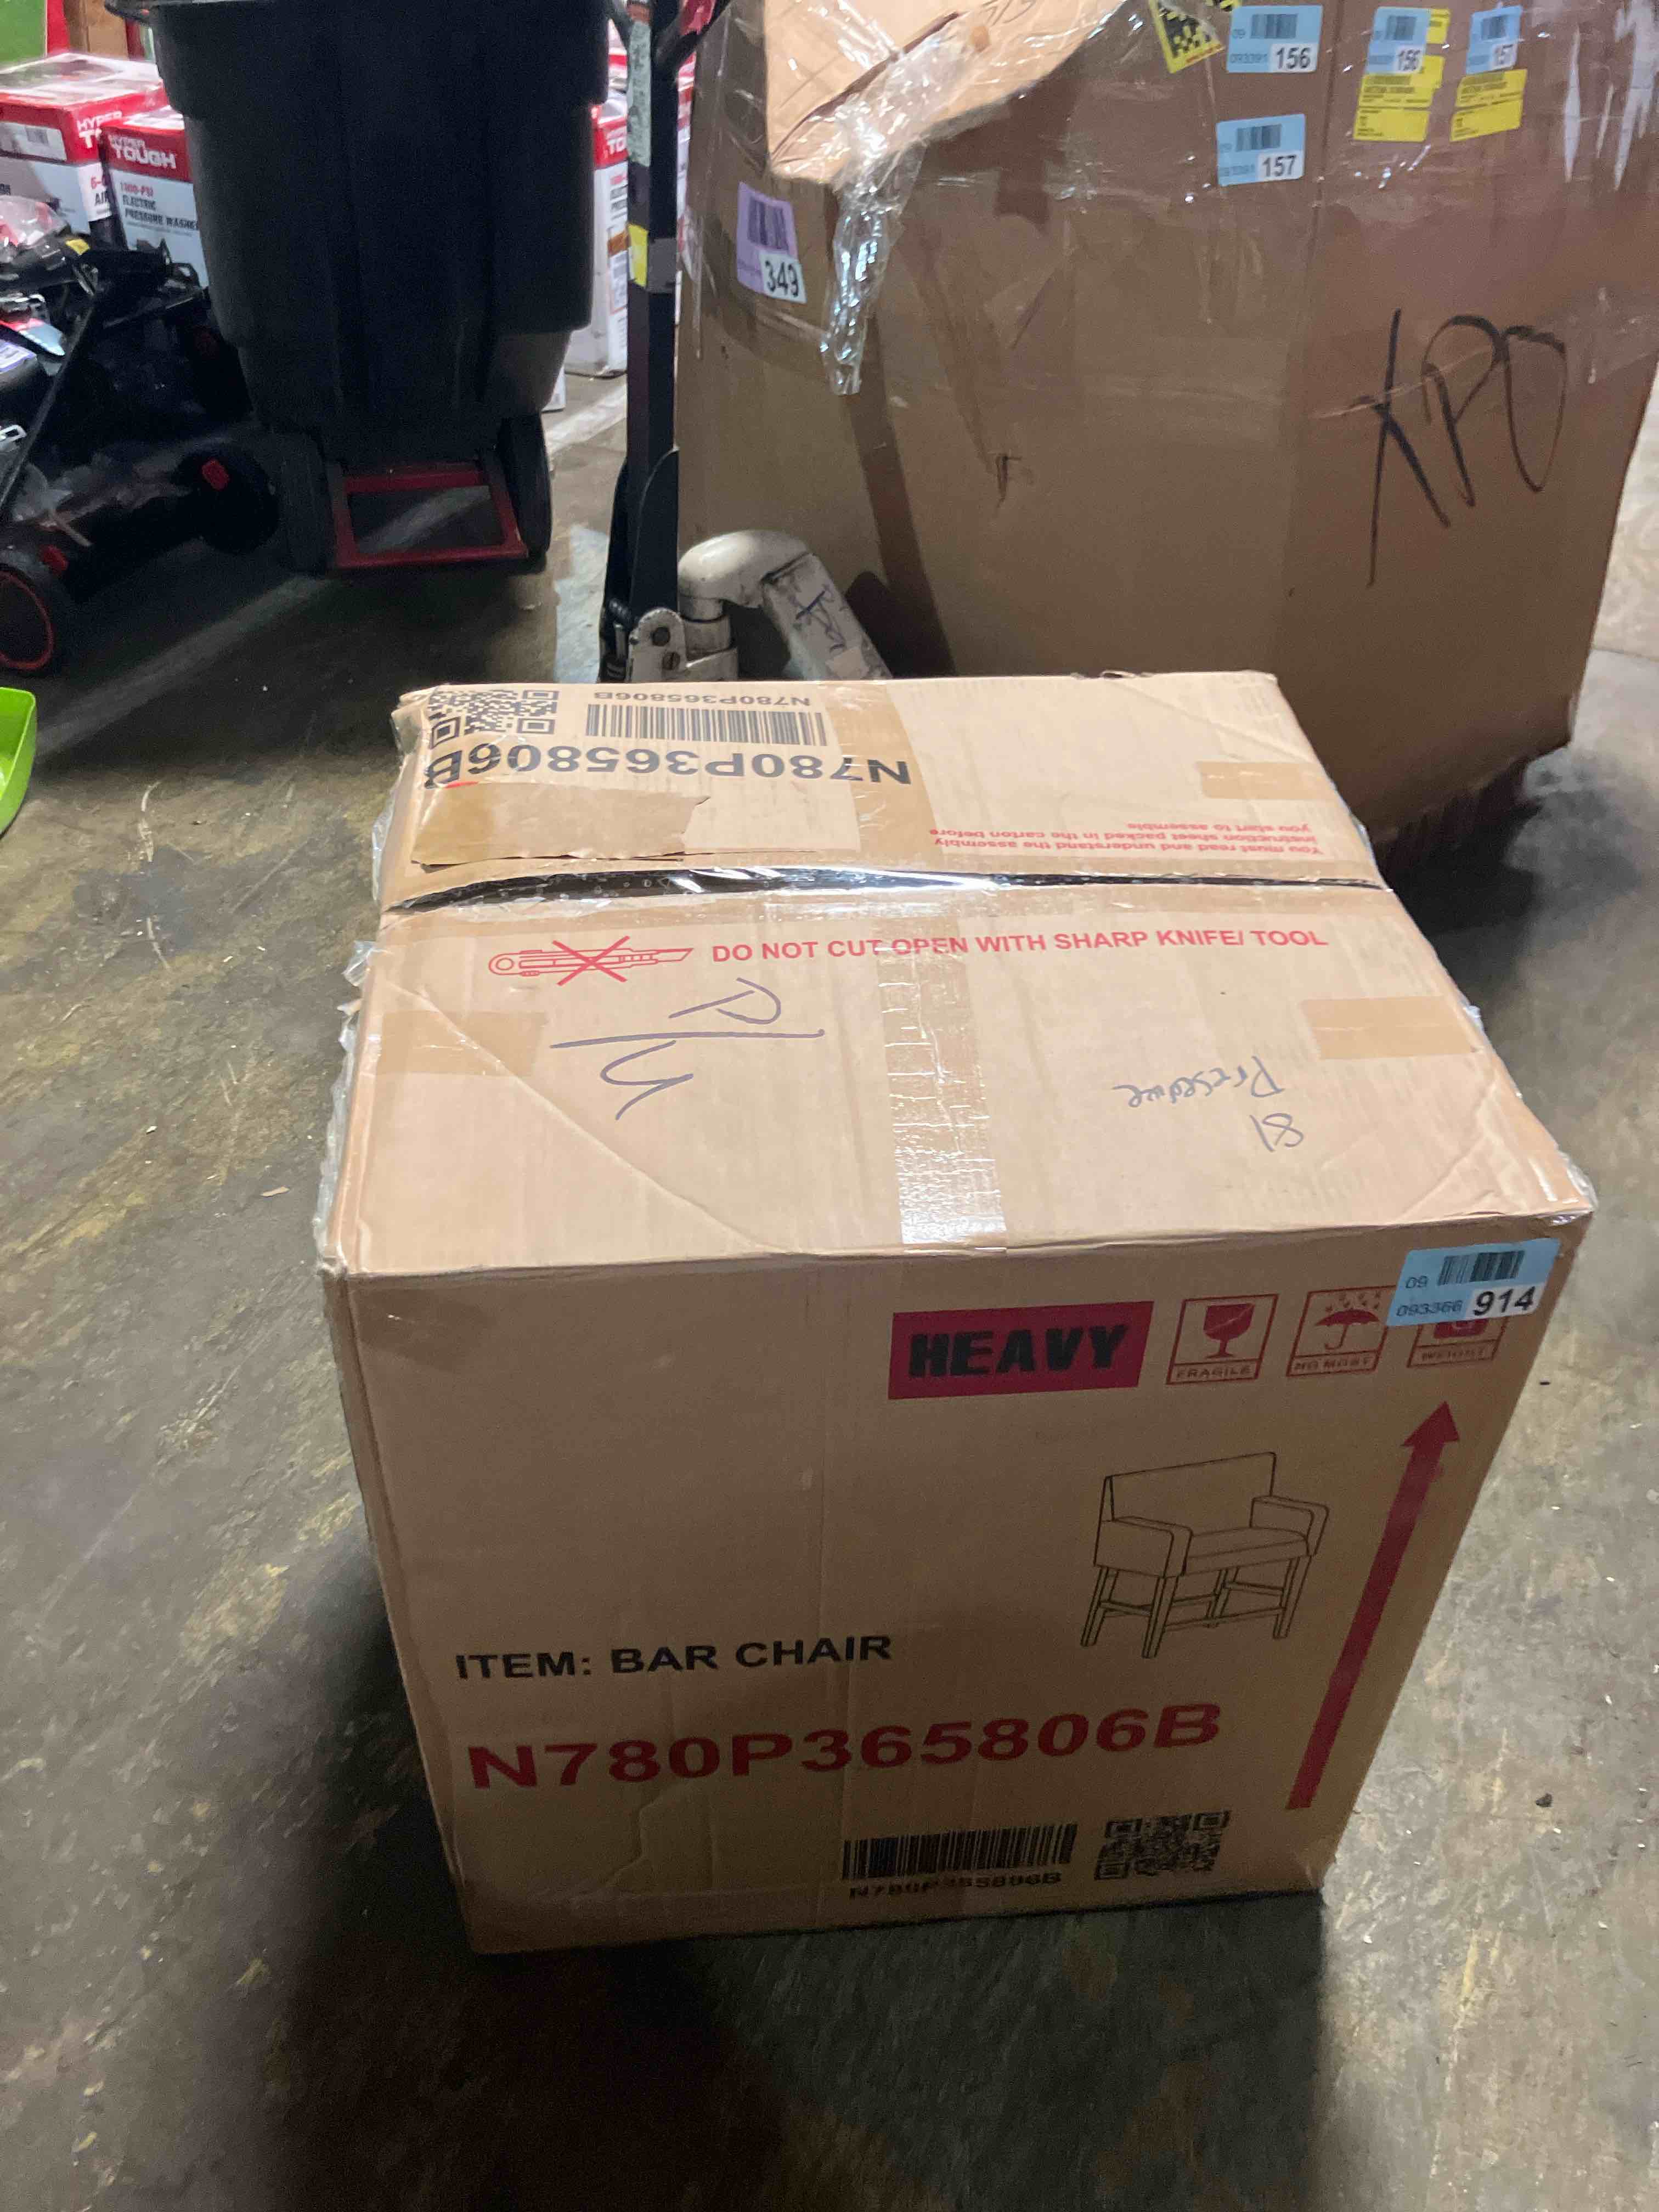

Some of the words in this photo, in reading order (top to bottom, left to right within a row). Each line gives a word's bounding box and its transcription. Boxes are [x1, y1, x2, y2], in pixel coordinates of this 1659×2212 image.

[1277, 47, 1311, 70] 156
[112, 144, 177, 170] TOUGH
[1263, 154, 1296, 178] 157
[594, 691, 810, 707] N780P365806B
[424, 742, 911, 789] N780P365806B
[1127, 822, 1207, 831] assemble
[1278, 823, 1310, 832] you
[929, 828, 985, 838] before
[1051, 831, 1078, 839] the
[1104, 832, 1166, 840] packed
[1172, 833, 1218, 842] sheet
[934, 837, 1017, 848] assembly
[1223, 834, 1317, 843] instruction
[1023, 840, 1051, 849] the
[1056, 841, 1155, 850] understand
[1160, 842, 1192, 851] and
[1198, 843, 1235, 851] read
[1240, 844, 1284, 853] must
[1289, 845, 1324, 855] You
[713, 944, 753, 962] DO
[762, 941, 818, 960] NOT
[827, 939, 883, 958] CUT
[891, 937, 969, 956] OPEN
[975, 934, 1046, 953] WITH
[1054, 931, 1148, 950] SHARP
[1250, 930, 1329, 946] TOOL
[1405, 1276, 1429, 1289] 09
[1472, 1286, 1536, 1316] 914
[908, 1324, 1128, 1379] HEAVY
[1177, 1365, 1252, 1379] FRAGILE
[455, 1651, 592, 1681] ITEM:
[611, 1645, 718, 1674] BAR
[735, 1635, 892, 1667] CHAIR
[466, 1702, 1221, 1790] N780P365806B
